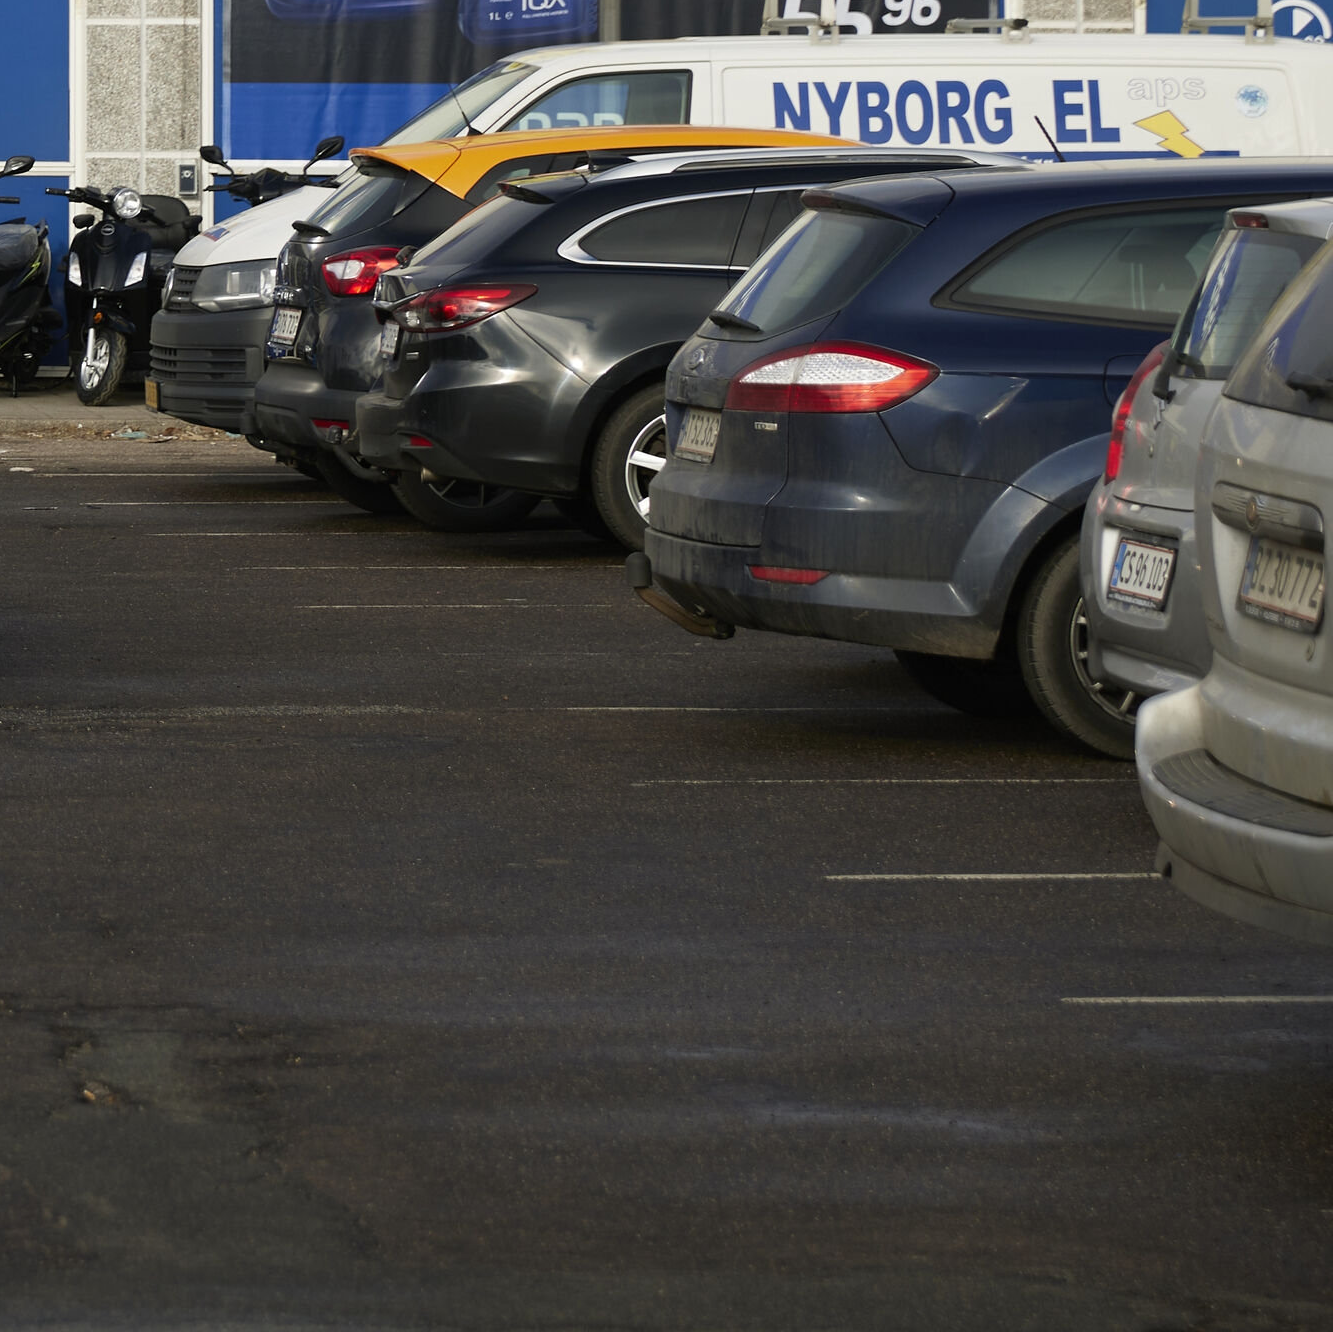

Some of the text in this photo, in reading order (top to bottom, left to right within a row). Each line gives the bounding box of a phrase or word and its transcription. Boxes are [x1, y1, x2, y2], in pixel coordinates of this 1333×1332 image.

[773, 77, 1206, 145] NYBORG EL aps
[1119, 550, 1169, 592] CS 96 103
[1251, 546, 1324, 608] BZ 30 772
